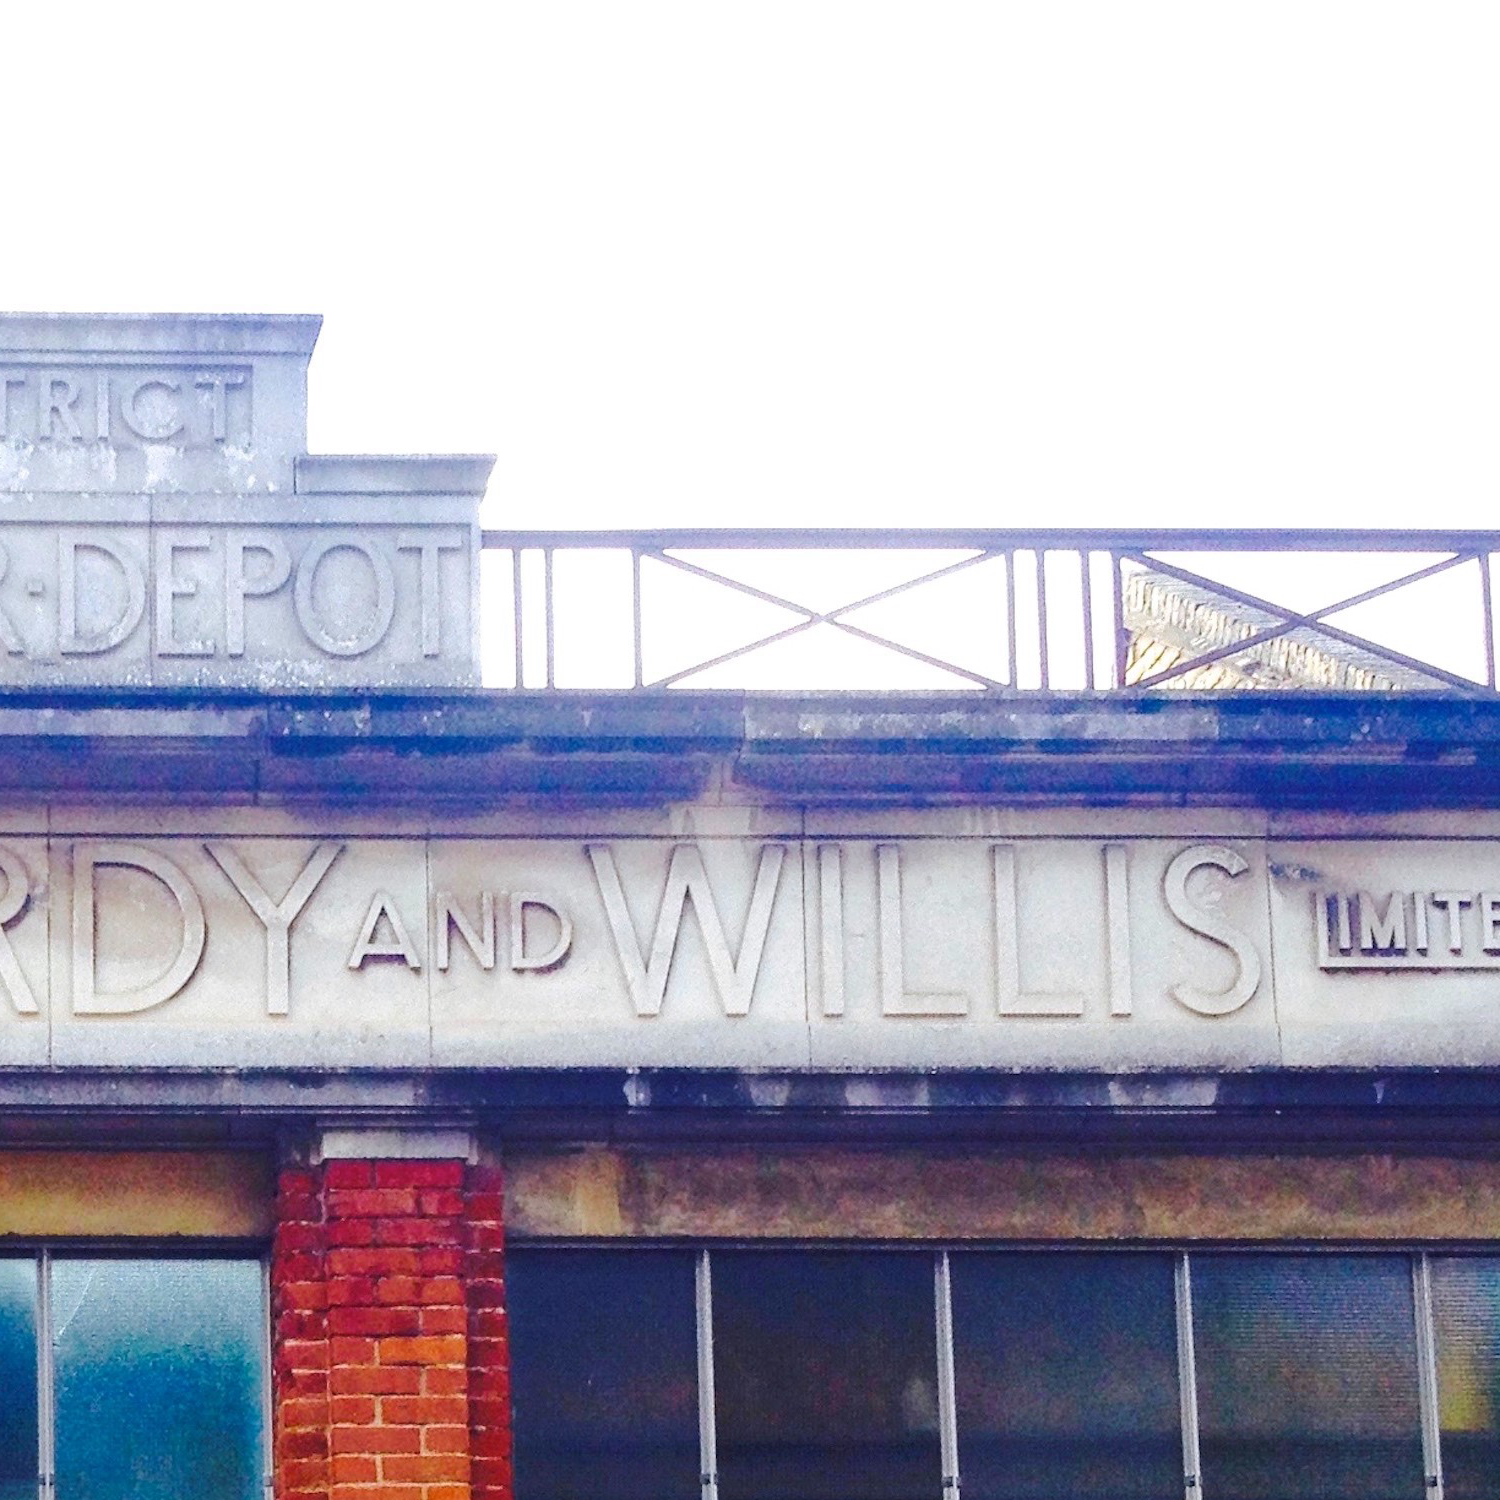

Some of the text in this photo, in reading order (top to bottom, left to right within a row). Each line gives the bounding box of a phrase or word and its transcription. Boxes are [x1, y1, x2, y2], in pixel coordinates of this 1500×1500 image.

[59, 532, 462, 661] DEPOT
[349, 891, 573, 973] AND
[584, 842, 1262, 1018] WILLIS
